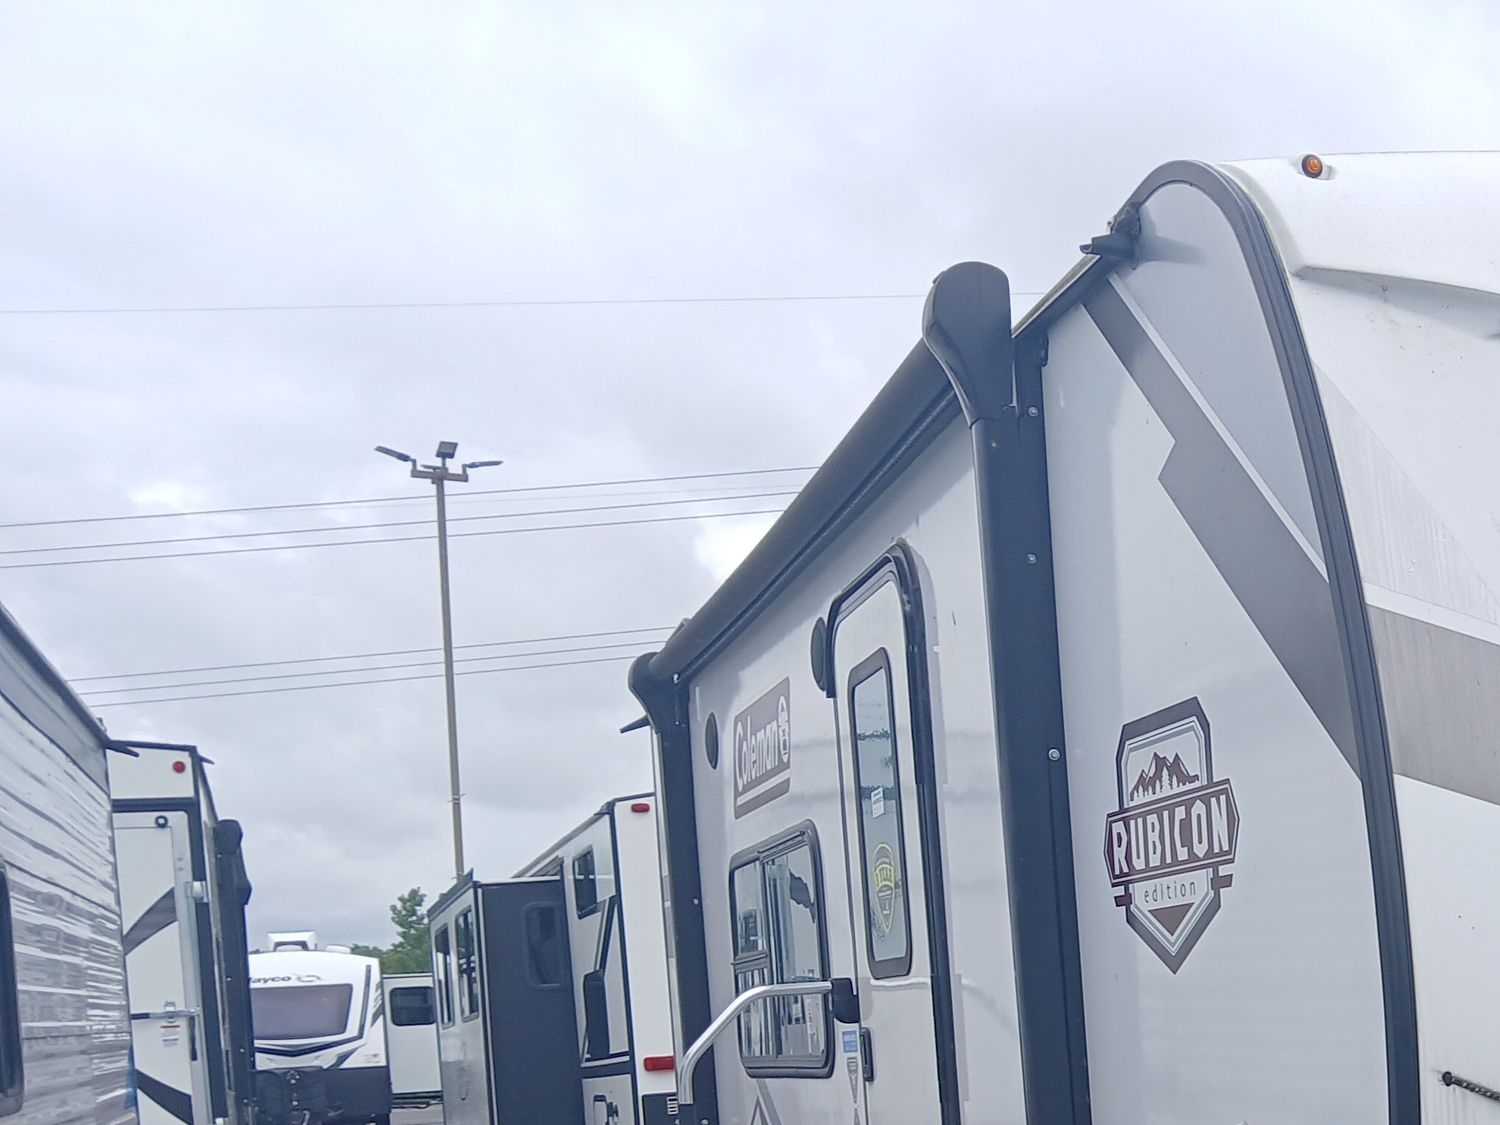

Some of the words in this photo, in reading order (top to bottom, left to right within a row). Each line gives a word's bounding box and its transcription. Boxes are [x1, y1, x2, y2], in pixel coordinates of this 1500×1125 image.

[735, 715, 779, 792] Coleman
[1111, 794, 1230, 876] RUBICON
[1144, 881, 1196, 904] edition
